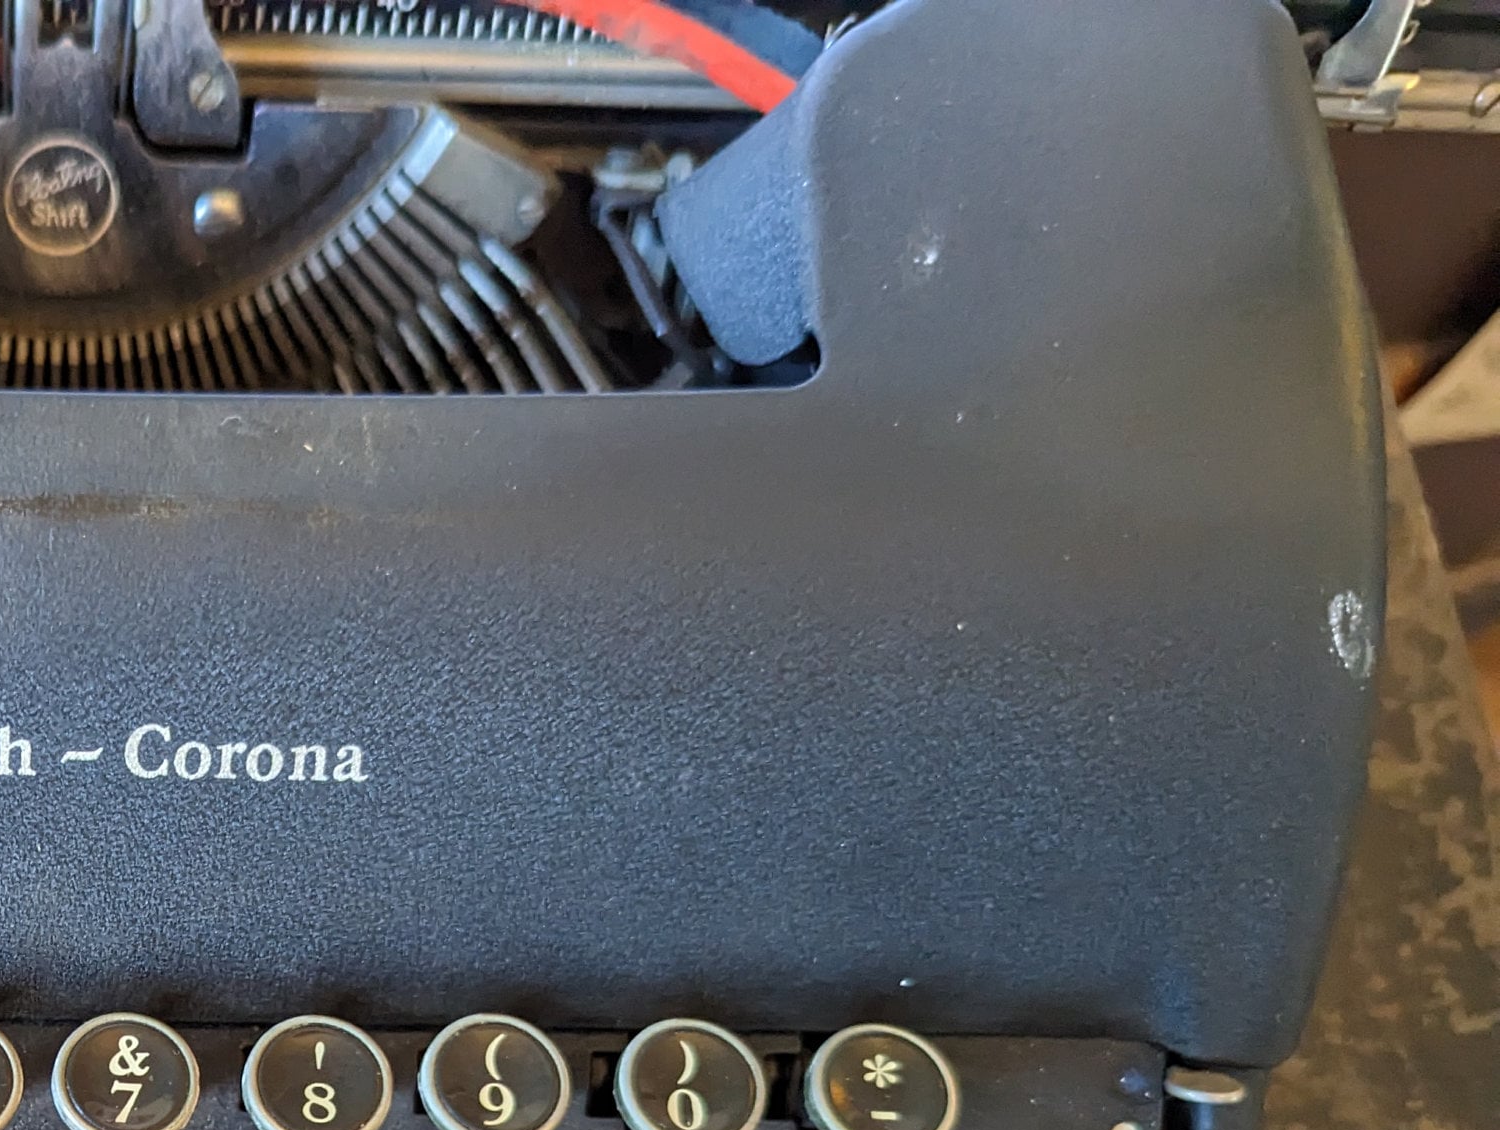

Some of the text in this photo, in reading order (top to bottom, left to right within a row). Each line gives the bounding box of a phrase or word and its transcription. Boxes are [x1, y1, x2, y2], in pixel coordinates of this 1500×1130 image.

[30, 200, 90, 229] Shift
[124, 722, 369, 783] Corona
[108, 1034, 151, 1077] &
[110, 1081, 144, 1123] 7
[302, 1082, 338, 1124] 8
[478, 1083, 514, 1127] 9
